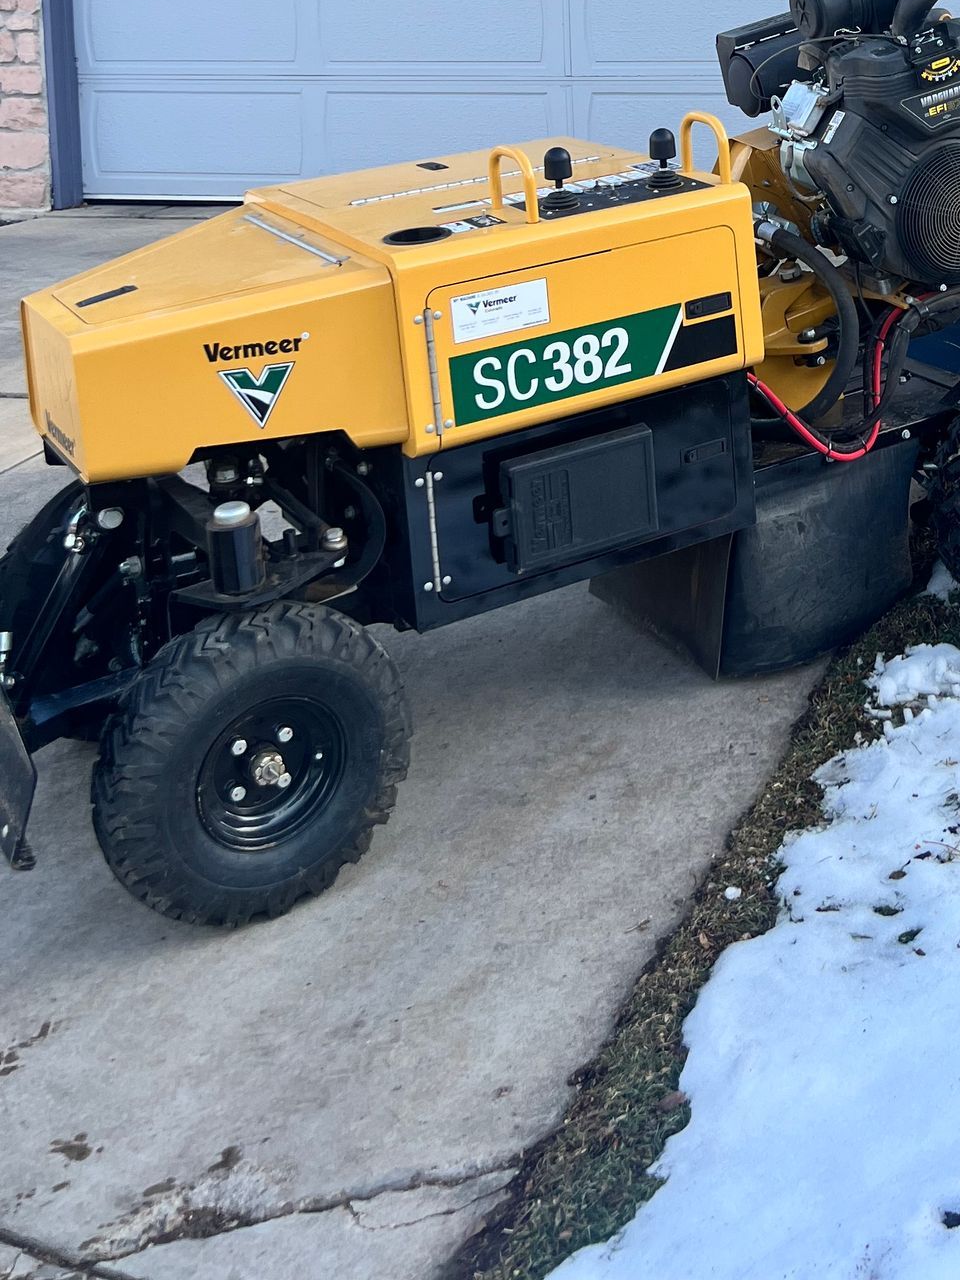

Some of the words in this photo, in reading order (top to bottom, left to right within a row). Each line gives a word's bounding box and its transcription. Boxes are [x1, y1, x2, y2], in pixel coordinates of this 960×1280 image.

[928, 103, 947, 116] EFI
[482, 296, 517, 307] Vermeer
[203, 337, 302, 363] Vermeer
